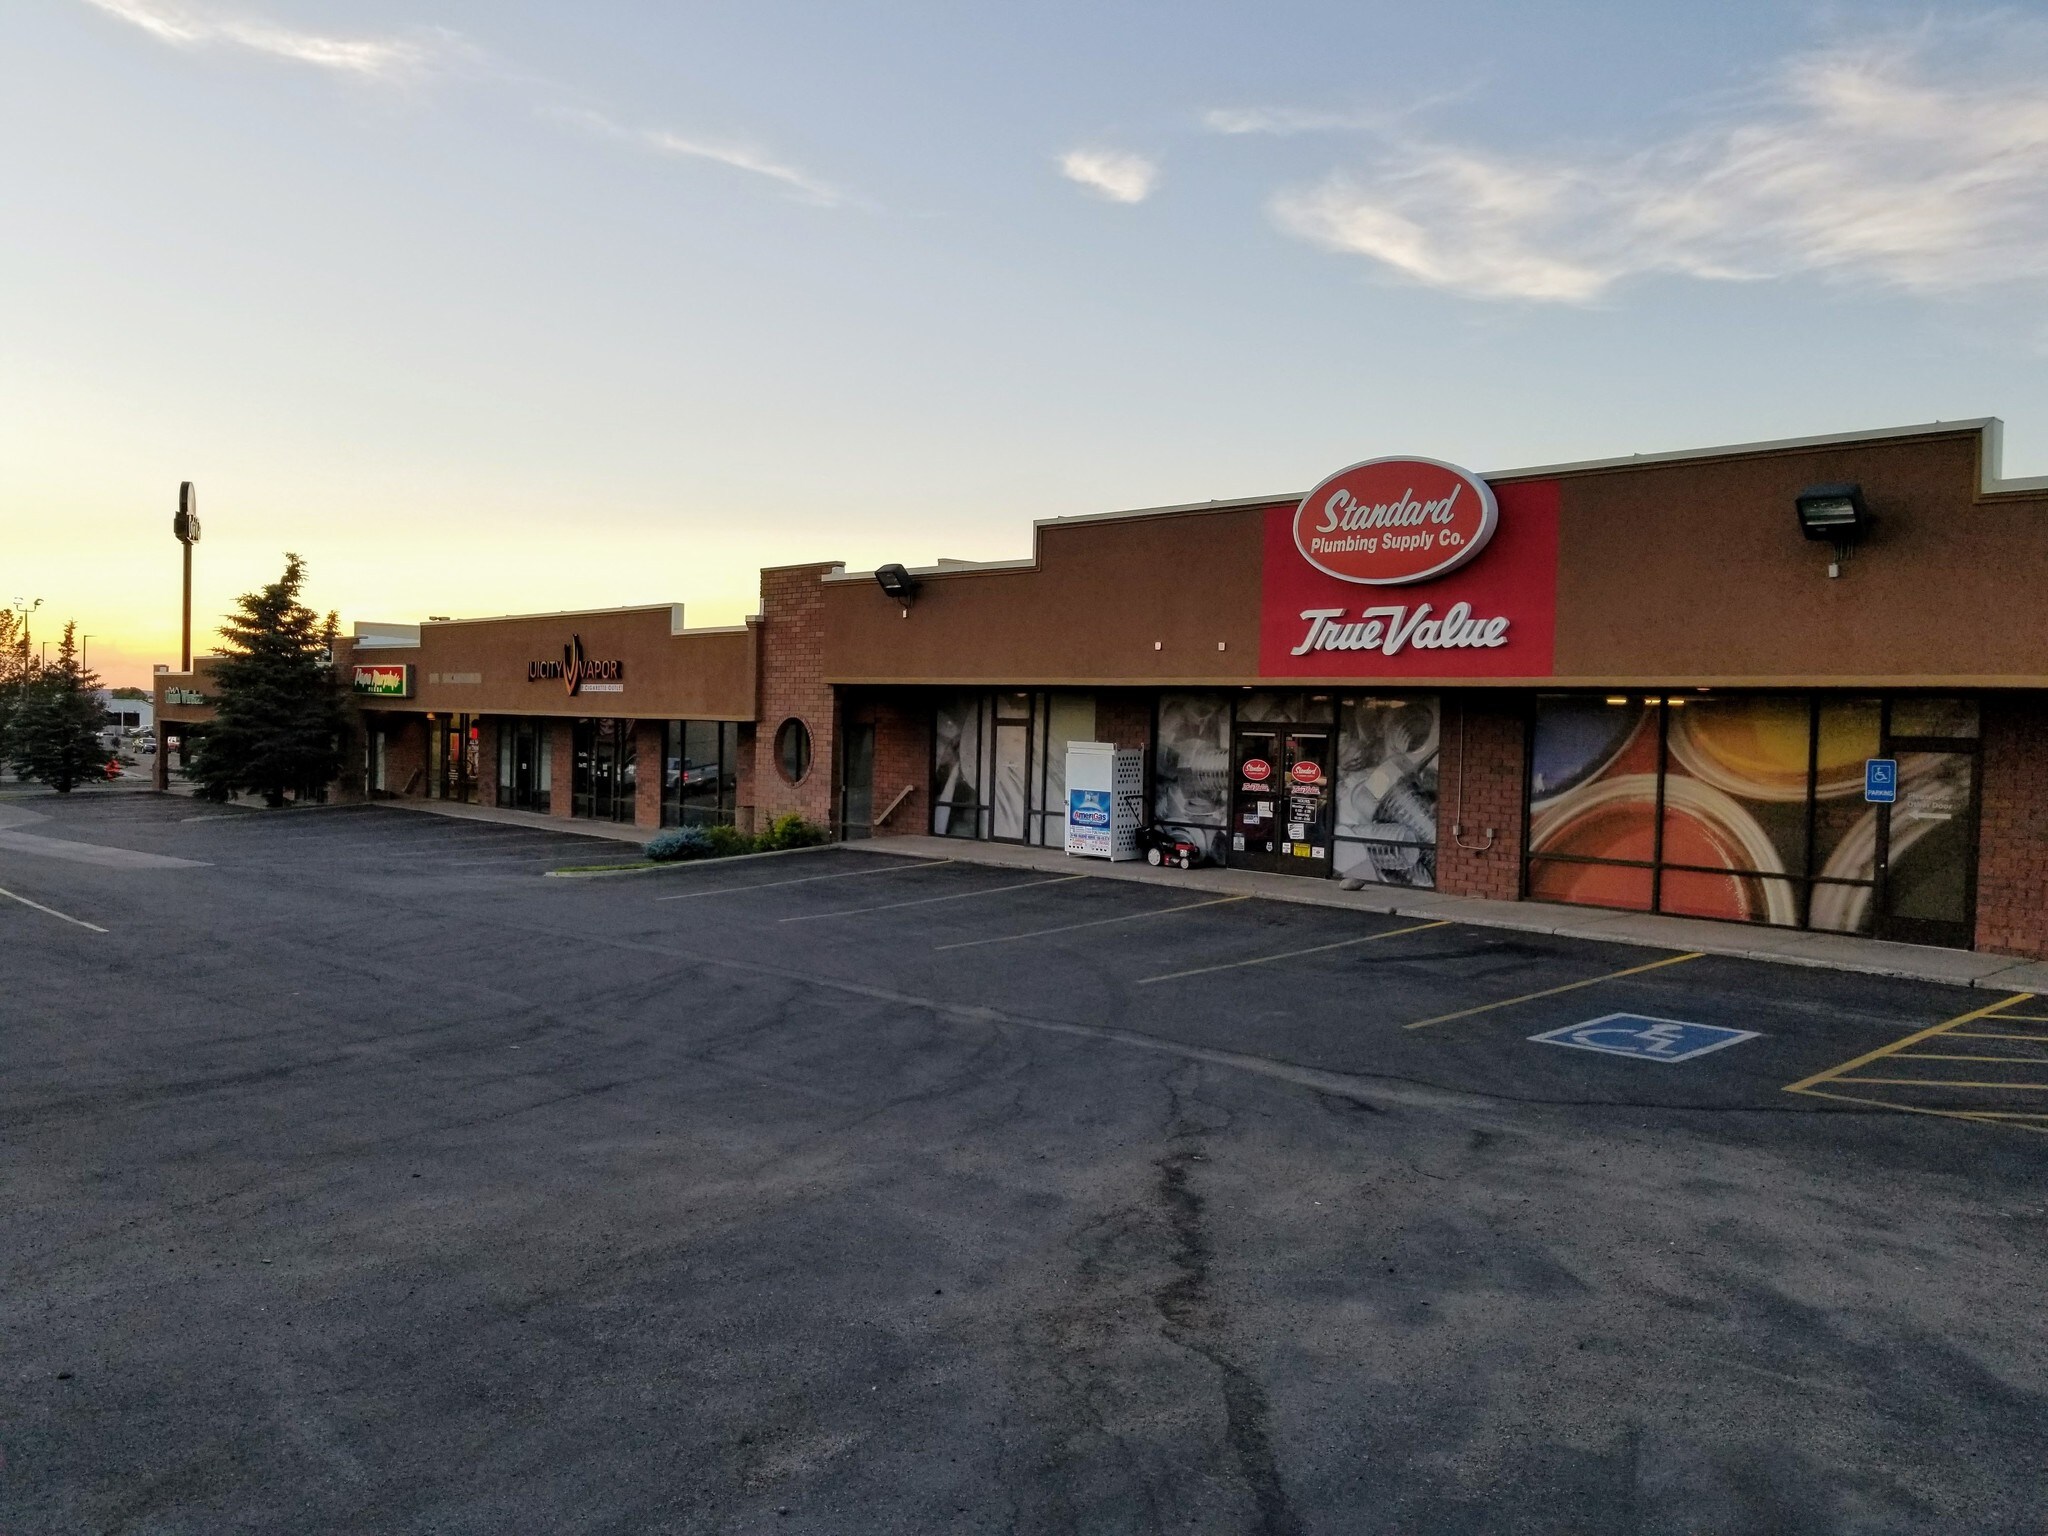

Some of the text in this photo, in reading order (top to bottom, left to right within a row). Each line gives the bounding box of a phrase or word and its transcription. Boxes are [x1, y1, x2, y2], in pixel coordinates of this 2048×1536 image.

[1316, 483, 1462, 533] Standard
[1311, 529, 1465, 553] Plumbing Supply Co.
[528, 661, 619, 682] UICITY VAPOR
[1868, 789, 1894, 797] PARKING
[1932, 802, 1953, 810] Door
[1073, 810, 1107, 821] AmeriGas
